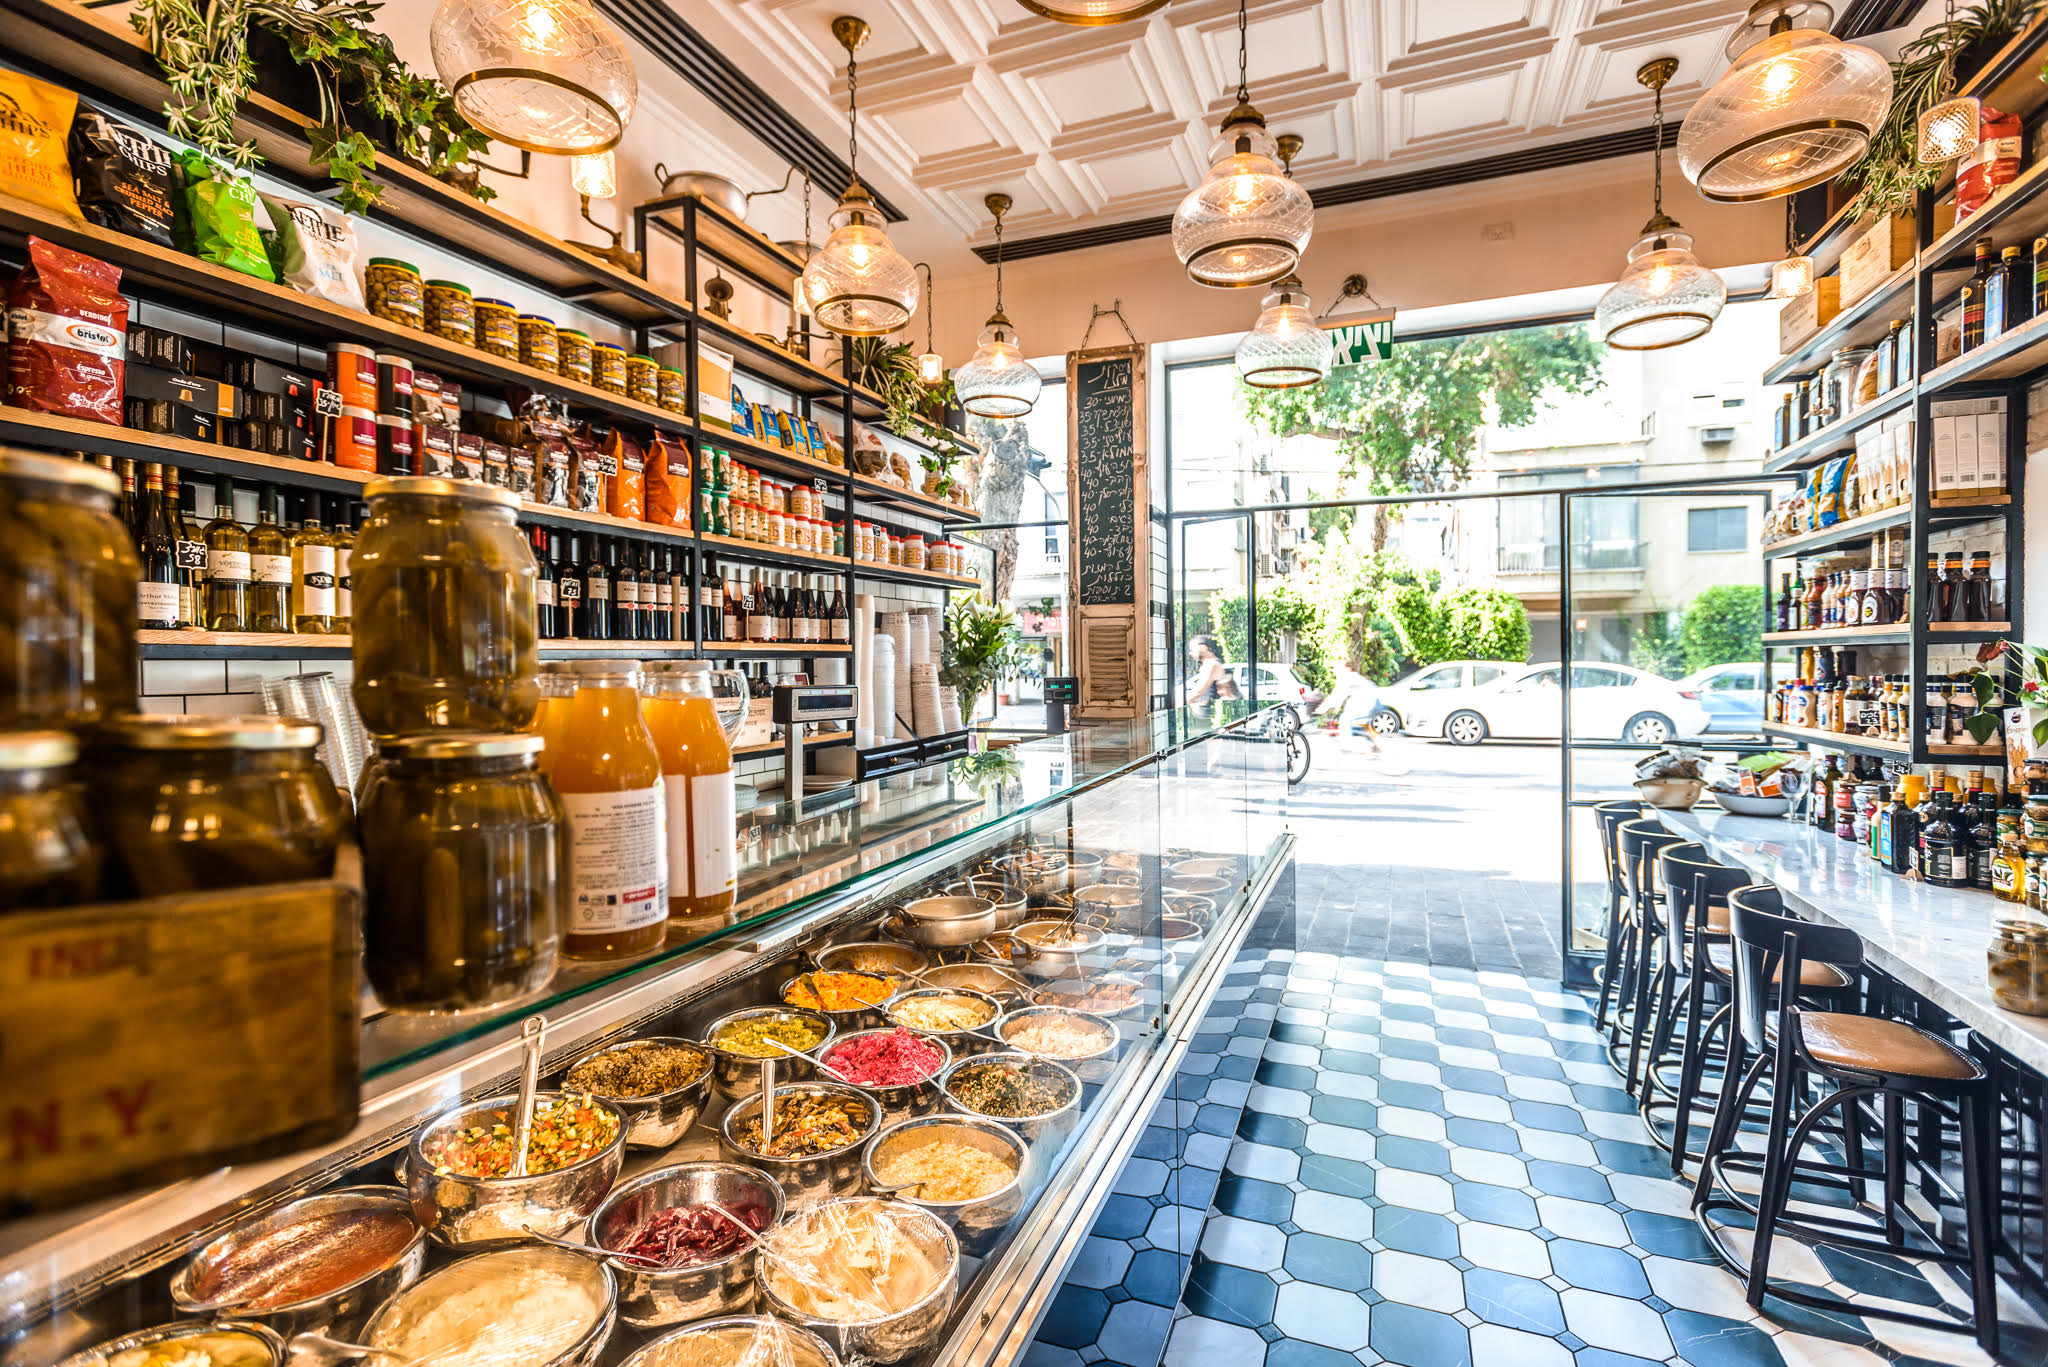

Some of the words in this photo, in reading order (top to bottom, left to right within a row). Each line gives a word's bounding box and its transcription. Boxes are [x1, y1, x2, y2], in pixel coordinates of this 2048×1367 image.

[81, 112, 171, 167] KETTLE
[119, 145, 168, 176] CHIPS
[113, 185, 153, 206] CRUSHED
[121, 181, 140, 194] SEA
[142, 187, 163, 203] SALT
[163, 200, 171, 209] &
[129, 196, 164, 219] PEPPER
[283, 203, 346, 242] KETTLE
[318, 267, 345, 282] SALT
[76, 328, 110, 344] bristol
[1331, 321, 1391, 366] יציא
[76, 363, 106, 376] Espresso
[1083, 397, 1099, 409] 30
[1079, 411, 1091, 424] 35
[1081, 424, 1096, 437] 35
[1104, 419, 1132, 433] שניצל
[1083, 436, 1097, 449] 35
[1114, 429, 1132, 443] עוף
[1081, 450, 1096, 463] 35
[1102, 445, 1133, 460] ממולא
[1110, 460, 1133, 473] חזה
[1080, 467, 1092, 481] 40
[1086, 478, 1099, 489] 40
[1081, 490, 1095, 502] 40
[1083, 503, 1096, 514] 40
[1084, 514, 1098, 525] 40
[1087, 524, 1099, 535] 40
[1083, 535, 1097, 546] 40
[1084, 547, 1097, 559] 40
[1116, 561, 1132, 571] כל
[1087, 571, 1133, 587] כוללות
[1081, 586, 1121, 597] תוספות
[1124, 584, 1132, 596] 2
[7, 1077, 174, 1164] N.Y.
